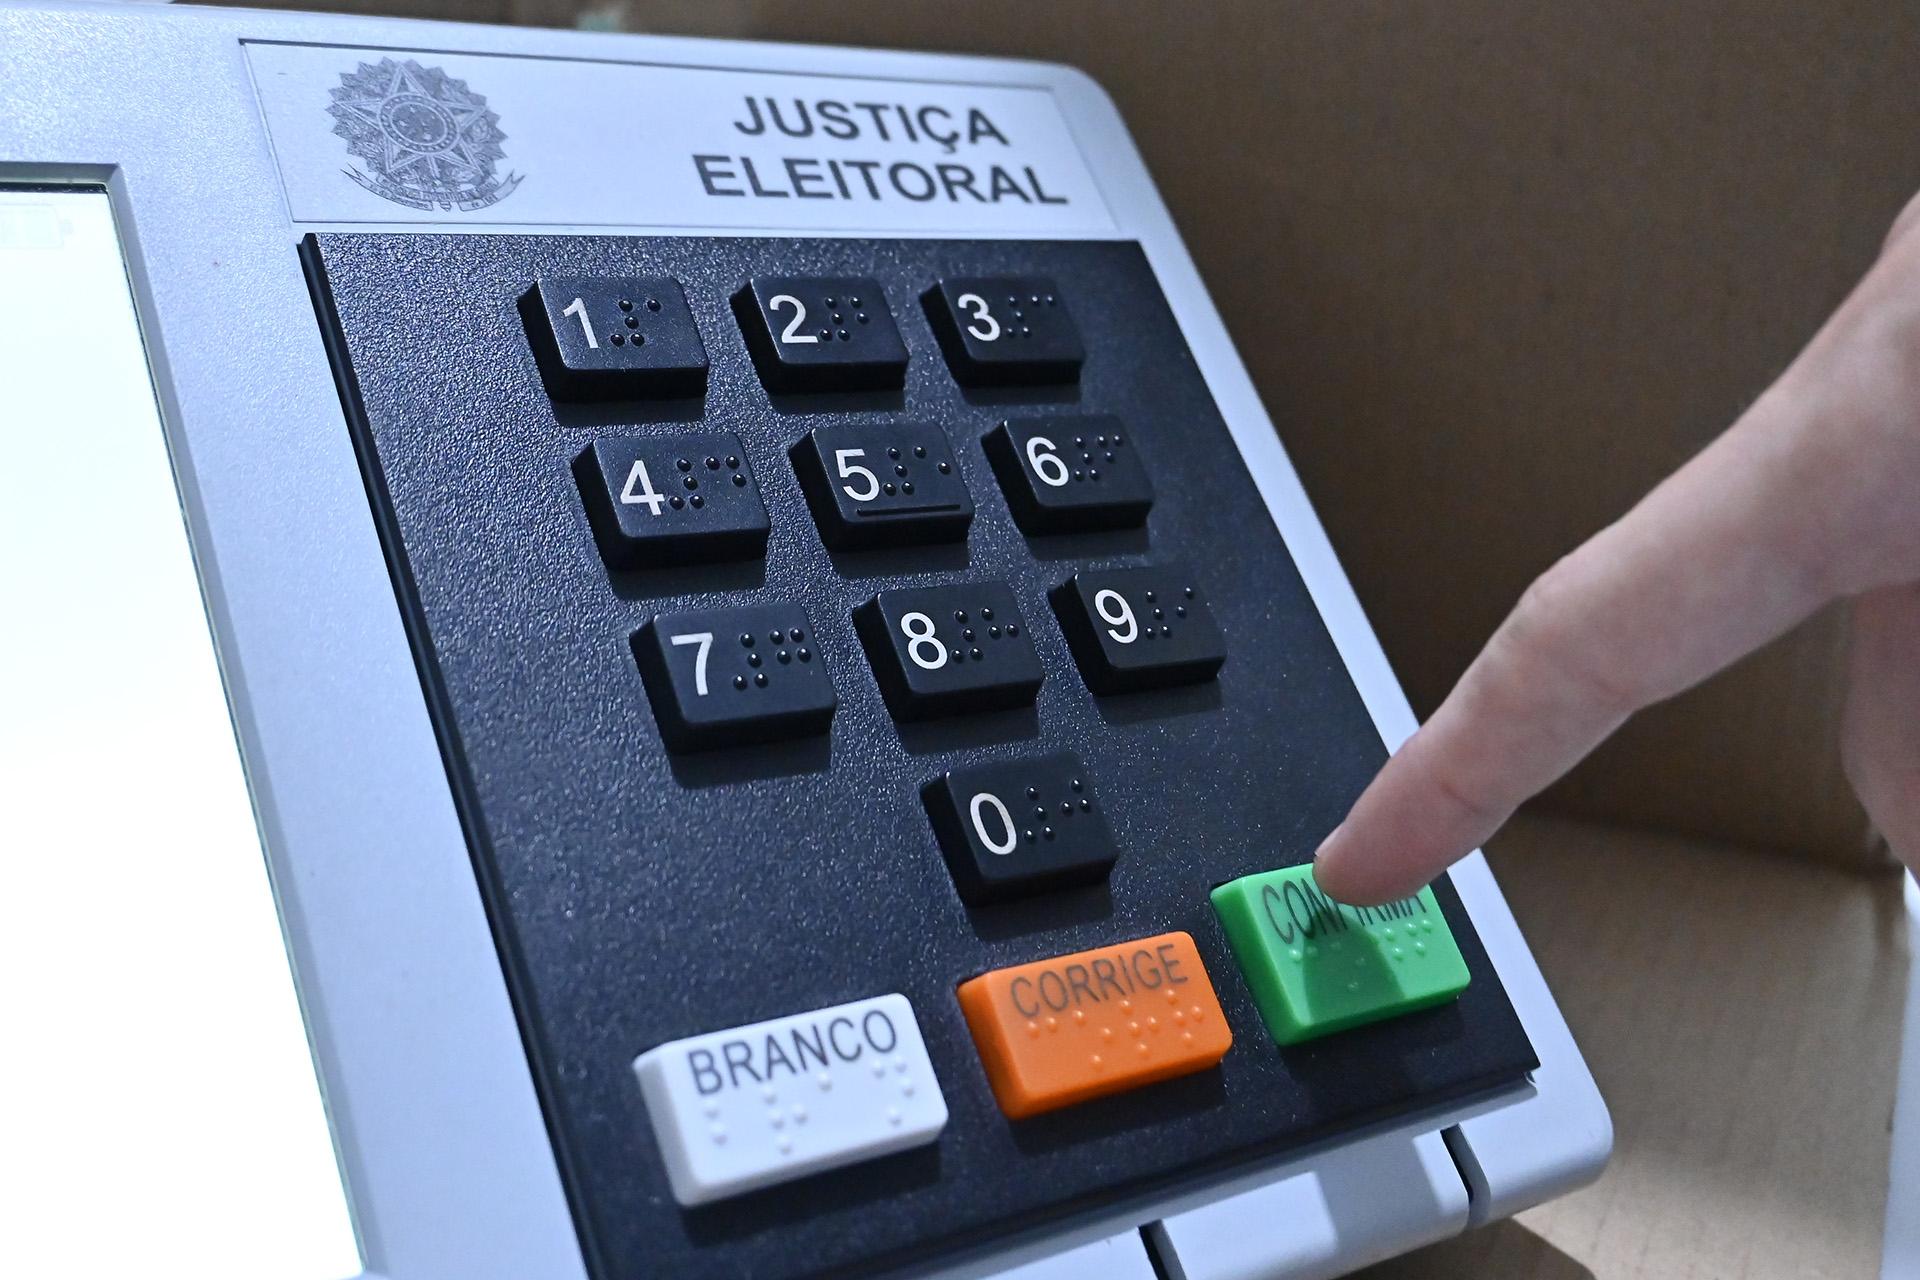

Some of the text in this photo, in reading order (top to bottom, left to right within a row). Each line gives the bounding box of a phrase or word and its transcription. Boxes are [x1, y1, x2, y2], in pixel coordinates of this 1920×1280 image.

[734, 96, 1010, 154] JUSTIÇA
[692, 154, 1069, 204] ELEITORAL
[562, 297, 599, 349] 1
[769, 294, 819, 344] 2
[957, 293, 1001, 342] 3
[619, 459, 666, 516] 4
[835, 448, 880, 502] 5
[1026, 436, 1069, 487] 6
[900, 612, 948, 670] 8
[1094, 589, 1138, 644] 9
[670, 632, 714, 696] 7
[969, 792, 1017, 855] 0
[1010, 943, 1189, 1020] CORRIGE
[687, 1009, 897, 1097] BRANCO
